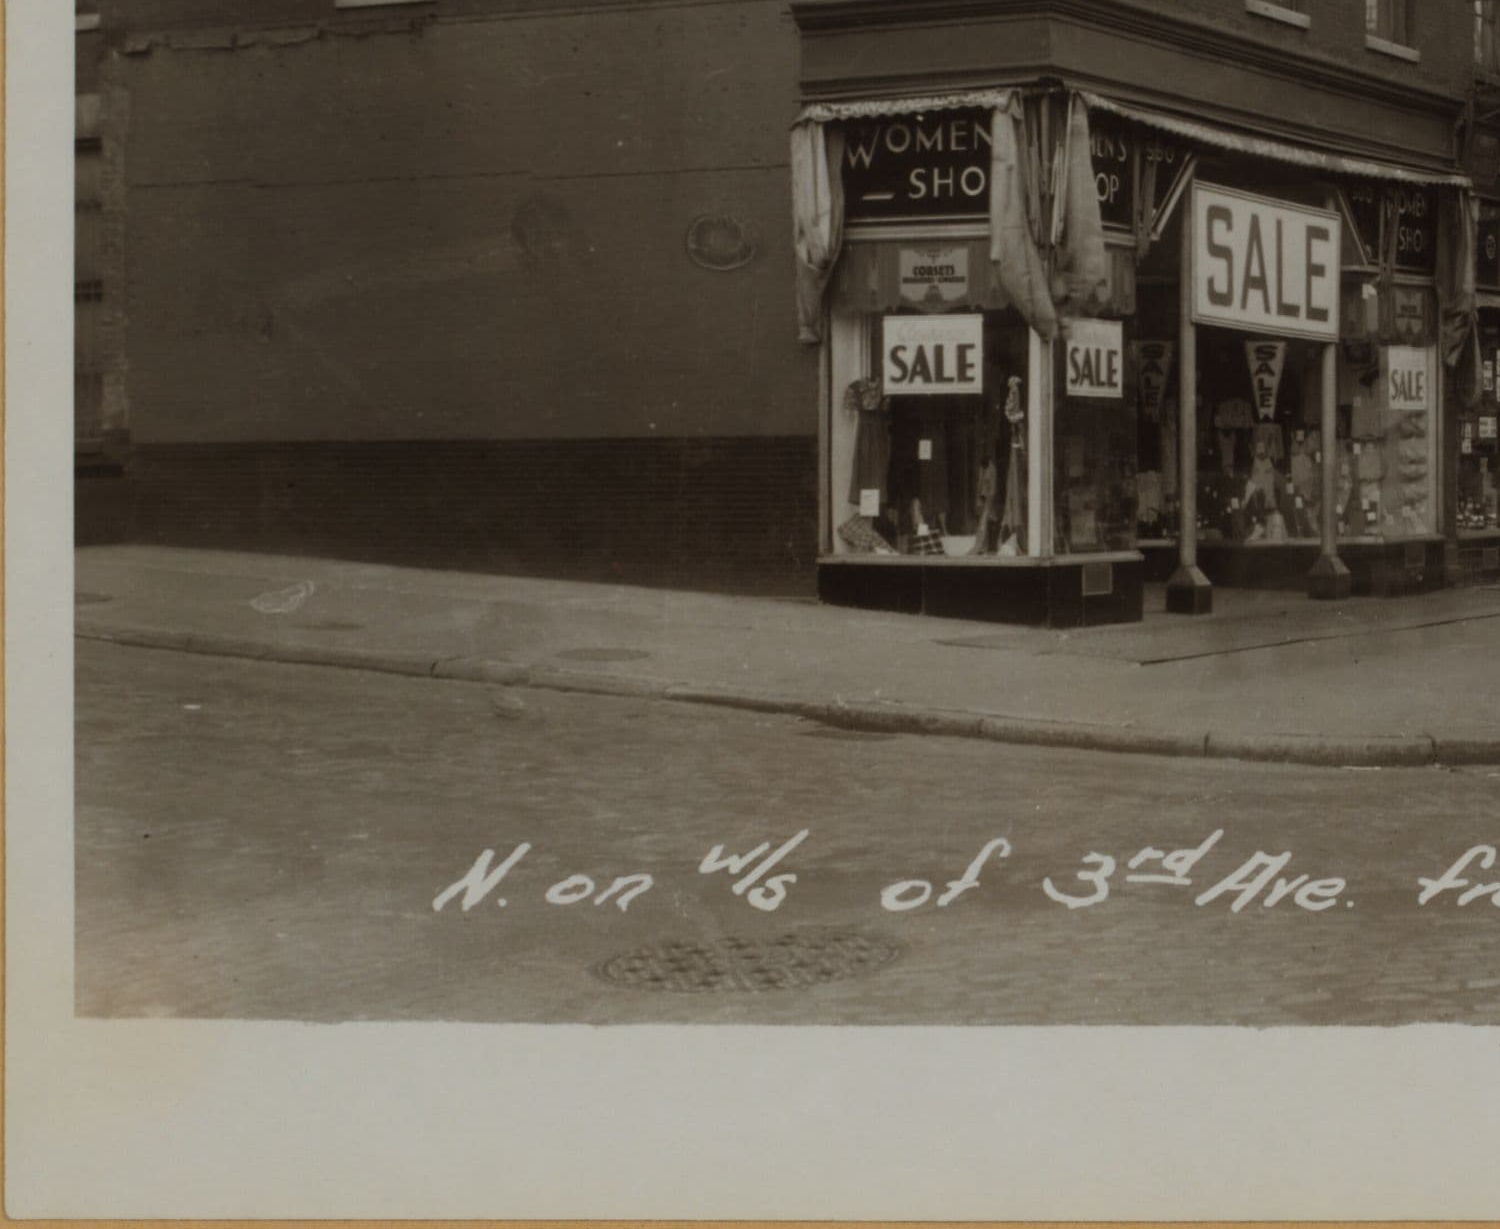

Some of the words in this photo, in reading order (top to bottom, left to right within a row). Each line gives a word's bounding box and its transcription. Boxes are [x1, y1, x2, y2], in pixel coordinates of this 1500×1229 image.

[908, 165, 987, 200] SHO
[1206, 204, 1330, 322] SALE
[889, 343, 976, 384] SALE
[1069, 346, 1119, 388] SALE
[1140, 342, 1165, 407] SALE
[1253, 343, 1278, 408] SALE
[1390, 370, 1425, 403] SALE
